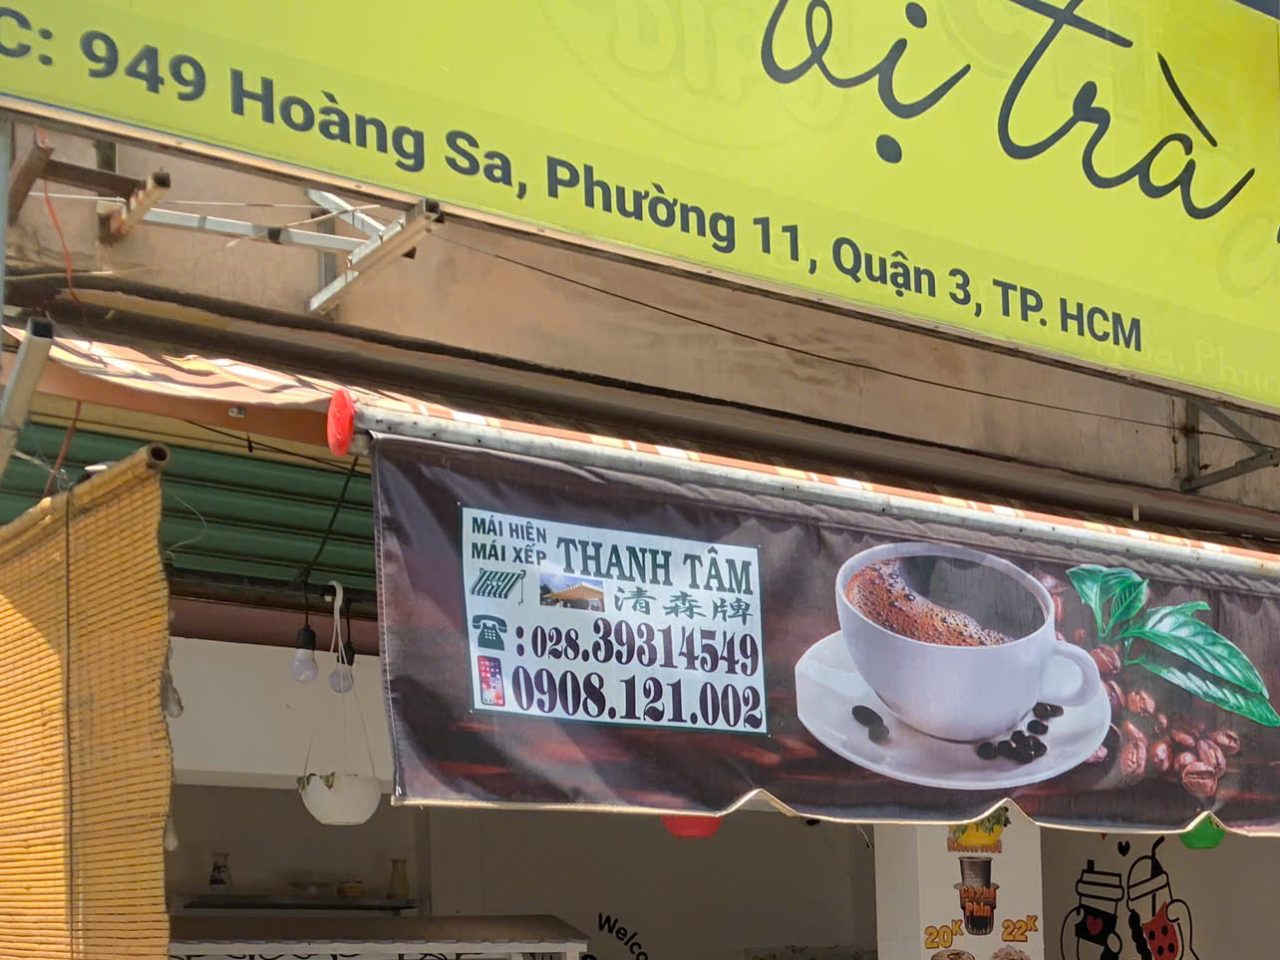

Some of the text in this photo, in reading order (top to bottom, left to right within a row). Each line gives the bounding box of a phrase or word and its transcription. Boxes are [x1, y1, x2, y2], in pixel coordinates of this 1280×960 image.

[998, 0, 1255, 220] trà
[80, 30, 206, 101] 949
[230, 67, 425, 173] Hoàng
[444, 129, 527, 200] Sa,
[546, 155, 736, 254] Phường
[752, 216, 818, 275] 11,
[832, 236, 936, 298] Quận
[948, 267, 983, 318] 3,
[992, 278, 1048, 327] TP.
[1059, 297, 1142, 352] HCM
[471, 515, 548, 543] MÁI HIÊN
[471, 536, 548, 566] MÁI XẾP
[556, 536, 754, 595] THANH TÂM
[511, 665, 763, 730] 0908.121.002
